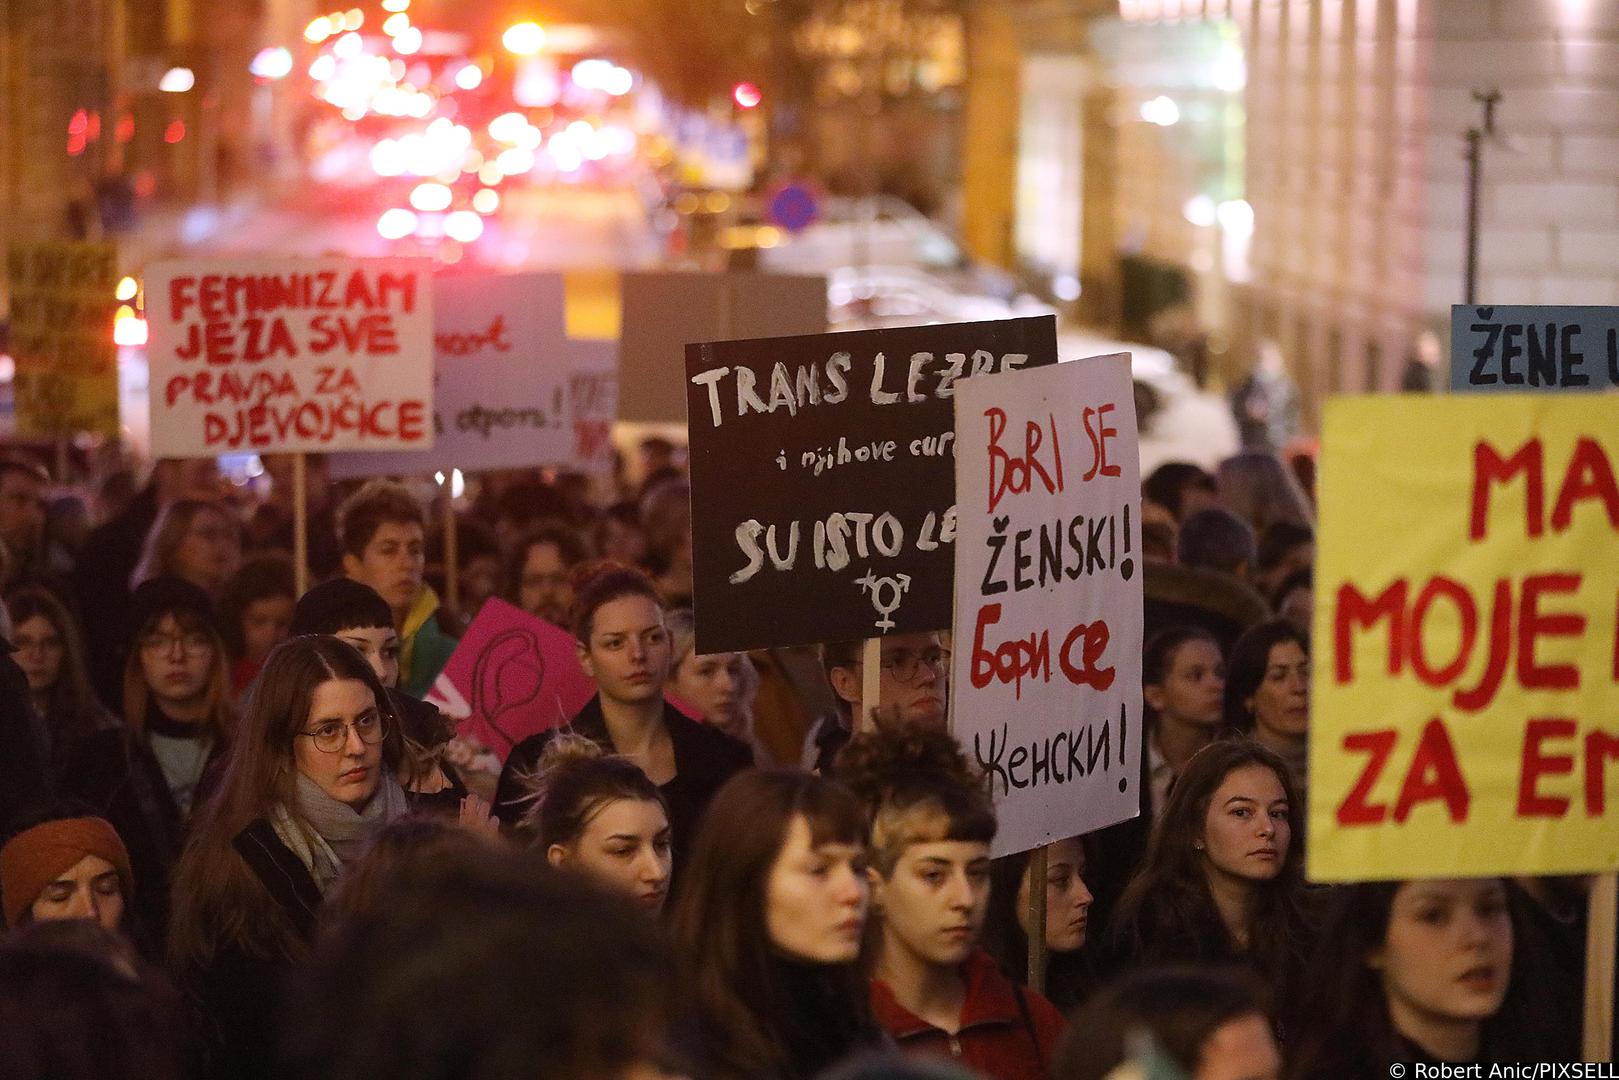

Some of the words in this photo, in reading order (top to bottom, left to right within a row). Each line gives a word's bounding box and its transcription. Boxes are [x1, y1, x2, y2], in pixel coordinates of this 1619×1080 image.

[169, 270, 417, 322] FEMINIZAM
[308, 314, 400, 355] SVE
[1469, 307, 1589, 387] ŽENE
[166, 371, 299, 408] PRAVDA
[316, 367, 360, 394] ZA
[692, 351, 851, 427] TRANS
[775, 450, 787, 471] i
[801, 436, 896, 477] njihove
[909, 430, 956, 457] cur
[1083, 403, 1122, 482] SE
[729, 519, 799, 585] SU
[814, 511, 904, 572] ISTO
[980, 502, 1134, 596] ŽENSKI!
[970, 602, 1049, 701] Бори
[1332, 571, 1589, 713] MOJE
[1335, 716, 1470, 828] ZA
